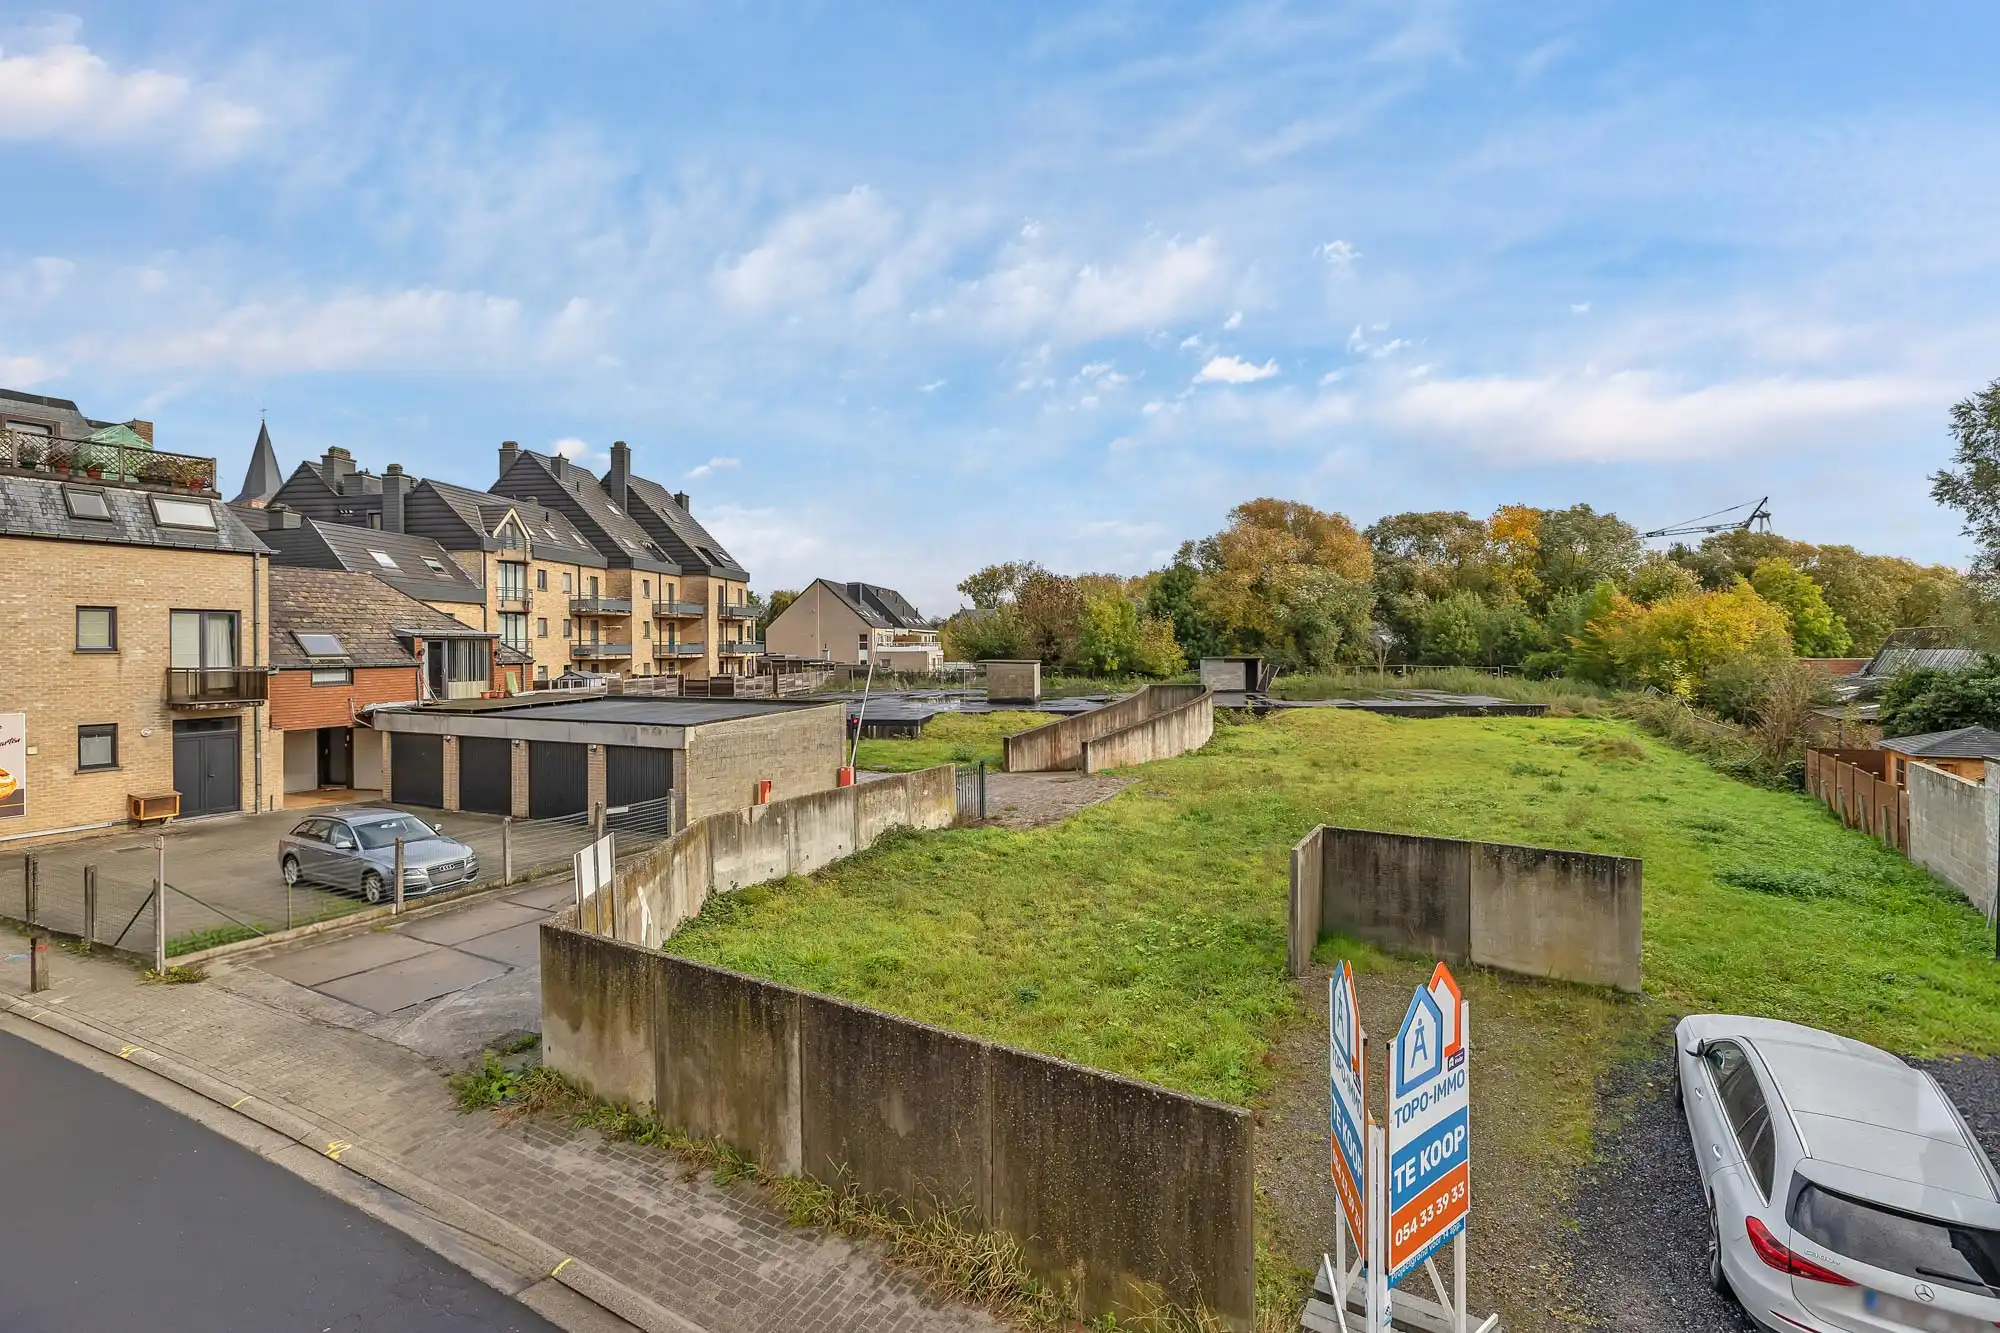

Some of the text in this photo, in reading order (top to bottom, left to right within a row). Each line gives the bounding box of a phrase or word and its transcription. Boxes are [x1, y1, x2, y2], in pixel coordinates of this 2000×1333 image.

[1394, 1068, 1466, 1129] TOPO-IMMO
[1332, 1093, 1363, 1178] TE KOOP
[1394, 1124, 1465, 1194] TE KOOP
[1395, 1181, 1464, 1247] 054 33 39 33
